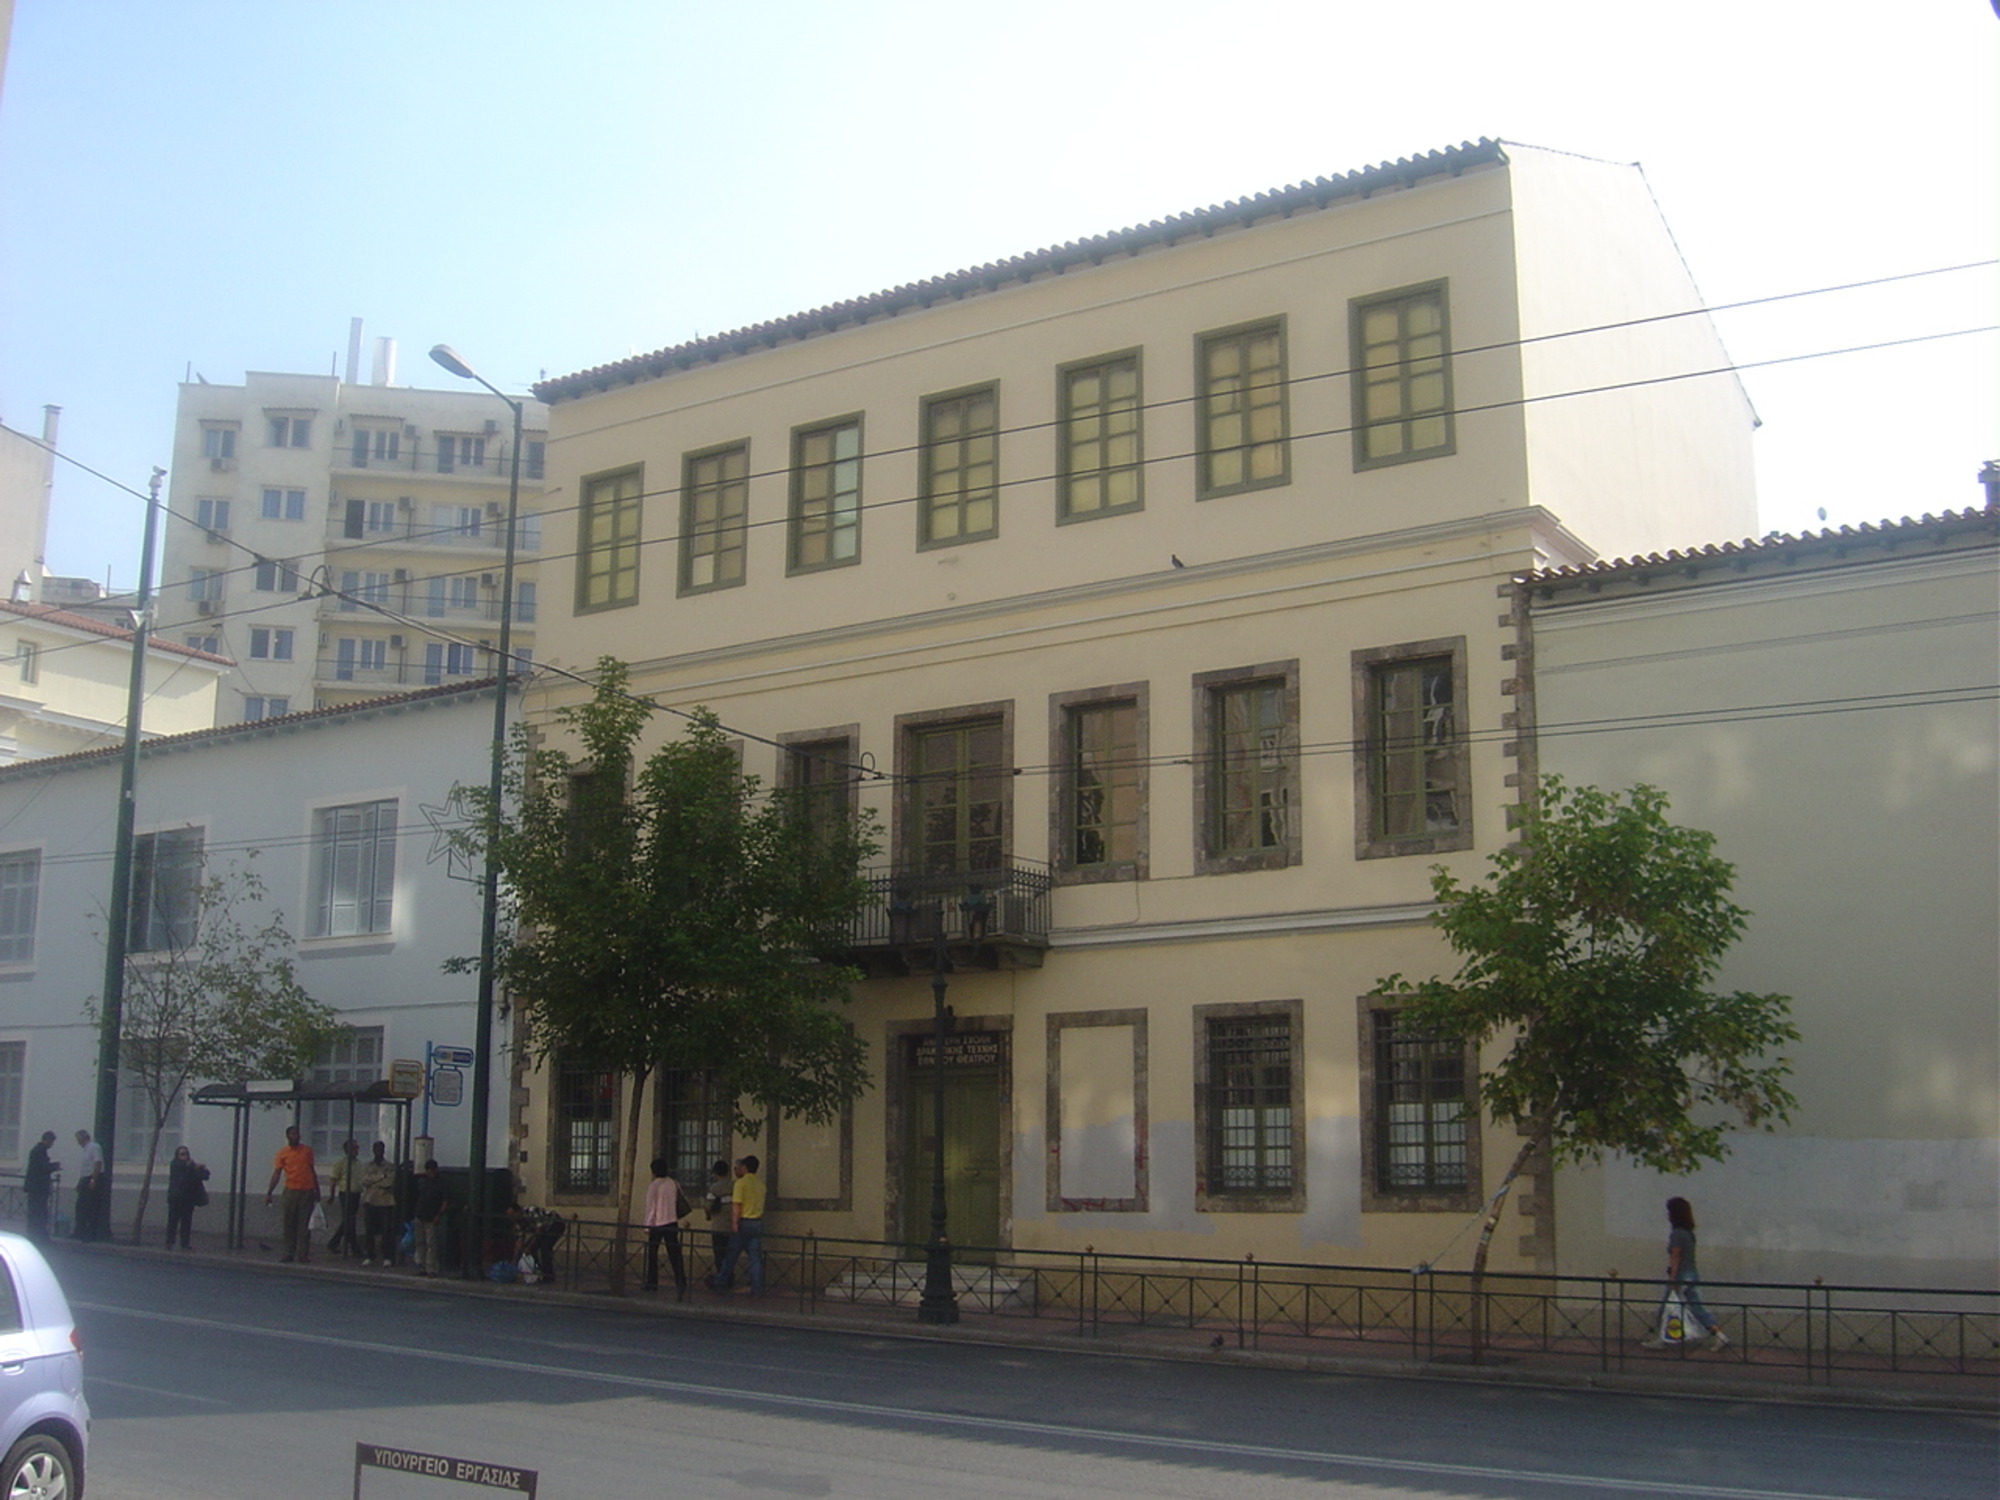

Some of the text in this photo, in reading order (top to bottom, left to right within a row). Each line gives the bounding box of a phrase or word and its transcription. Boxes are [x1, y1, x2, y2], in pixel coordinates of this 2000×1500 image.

[956, 1054, 996, 1064] ΘΕΑΤΡΟΥ
[374, 1448, 521, 1488] ΥΠΟΥΡΓΕΙΟ ΕΡΓΑΣΙΑΣ
